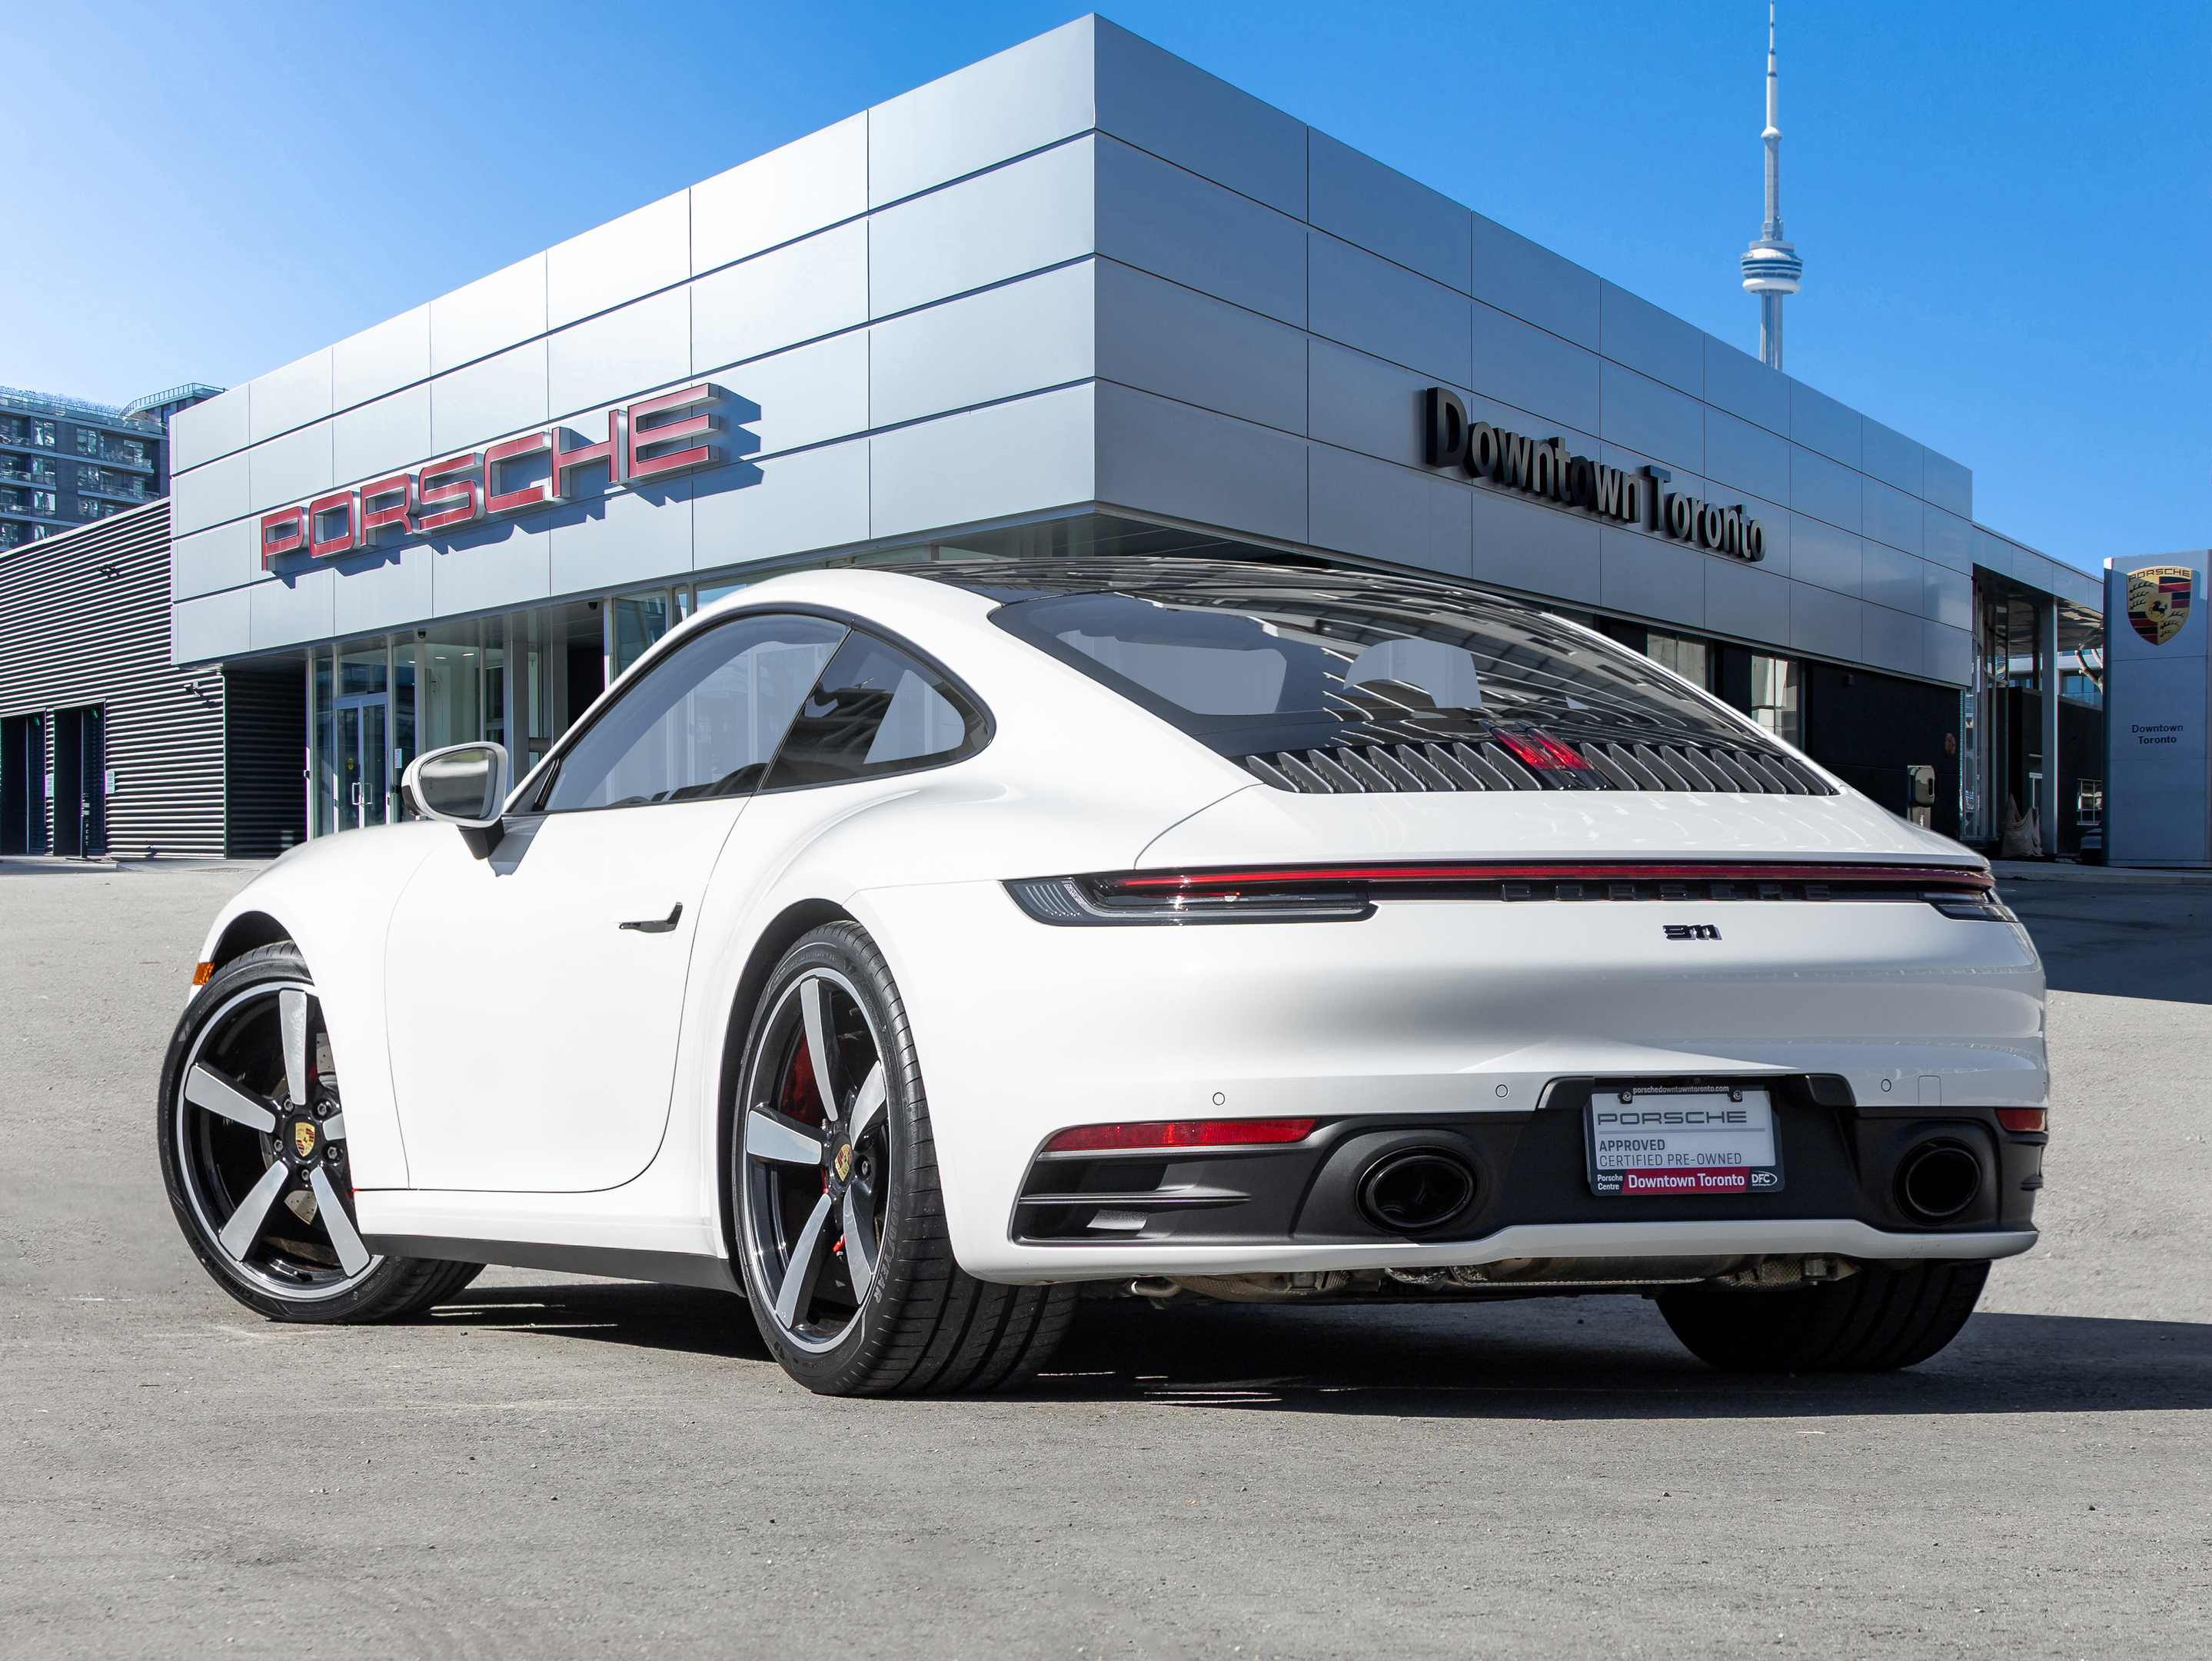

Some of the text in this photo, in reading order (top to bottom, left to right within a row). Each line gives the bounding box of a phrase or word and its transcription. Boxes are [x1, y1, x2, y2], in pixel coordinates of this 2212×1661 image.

[261, 383, 720, 571] PORSCHE
[1426, 386, 1767, 562] Downtown Toronto
[2128, 567, 2191, 582] PORSCHE
[2131, 724, 2184, 734] Downtown
[2137, 736, 2177, 744] Toronto
[1662, 924, 1722, 940] 911
[1632, 1085, 1729, 1095] porschedowntowntoronto.com
[1597, 1110, 1747, 1126] PORSCHE
[1599, 1139, 1665, 1152] APPROVED
[1599, 1153, 1742, 1167] CERTIFIED PRE-OWNED
[1628, 1173, 1745, 1189] Downtown Toronto
[1751, 1173, 1771, 1183] DFC
